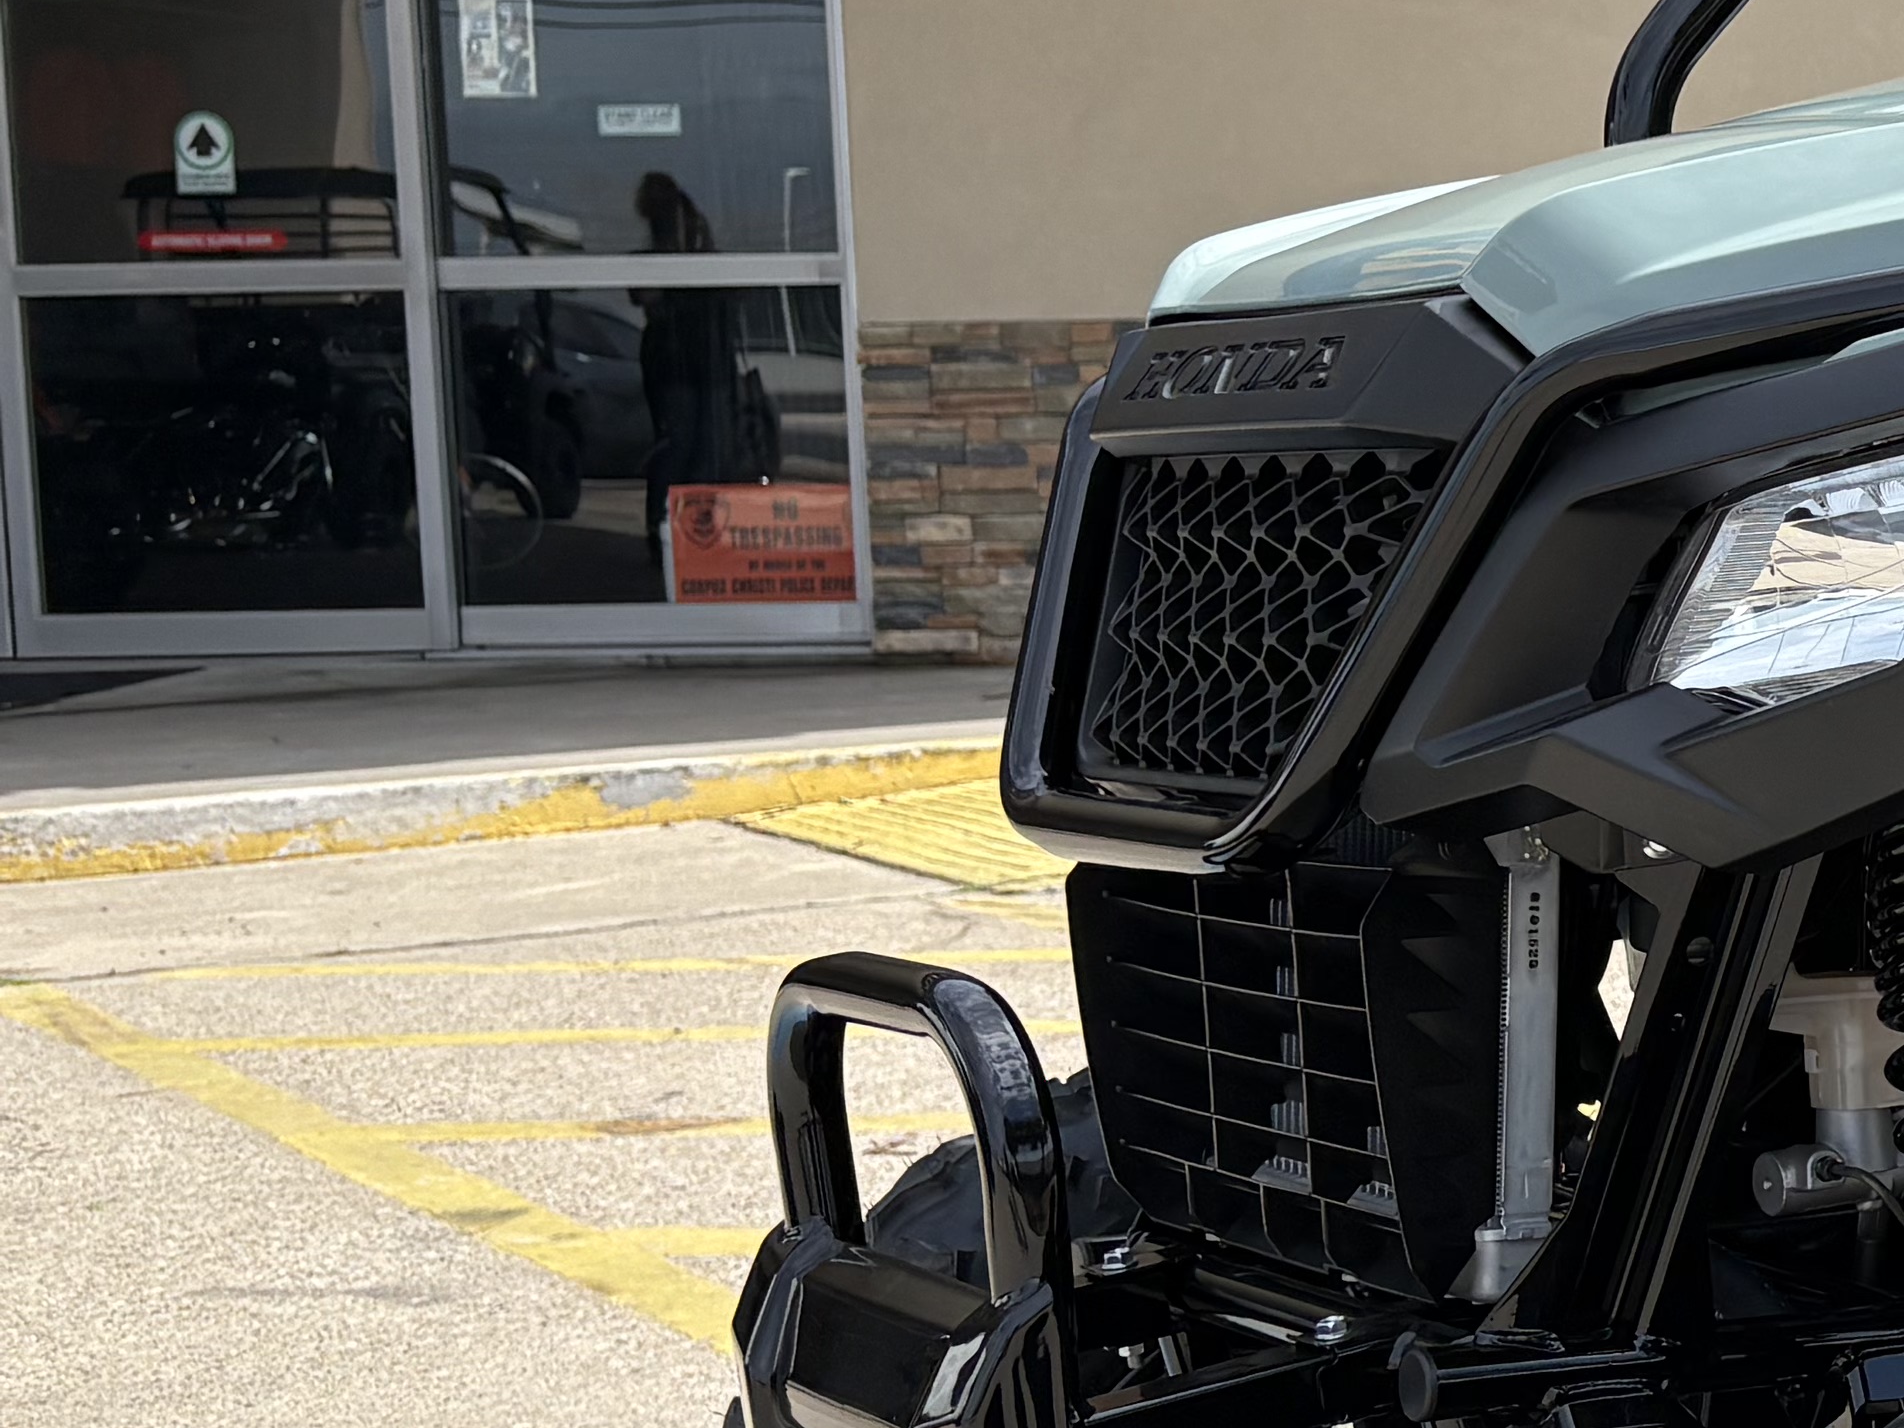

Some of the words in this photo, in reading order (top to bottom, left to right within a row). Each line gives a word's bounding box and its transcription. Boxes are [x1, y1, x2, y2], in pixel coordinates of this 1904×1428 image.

[1123, 335, 1346, 401] HONDA
[772, 497, 798, 521] NO
[730, 525, 844, 550] TRESPASSING
